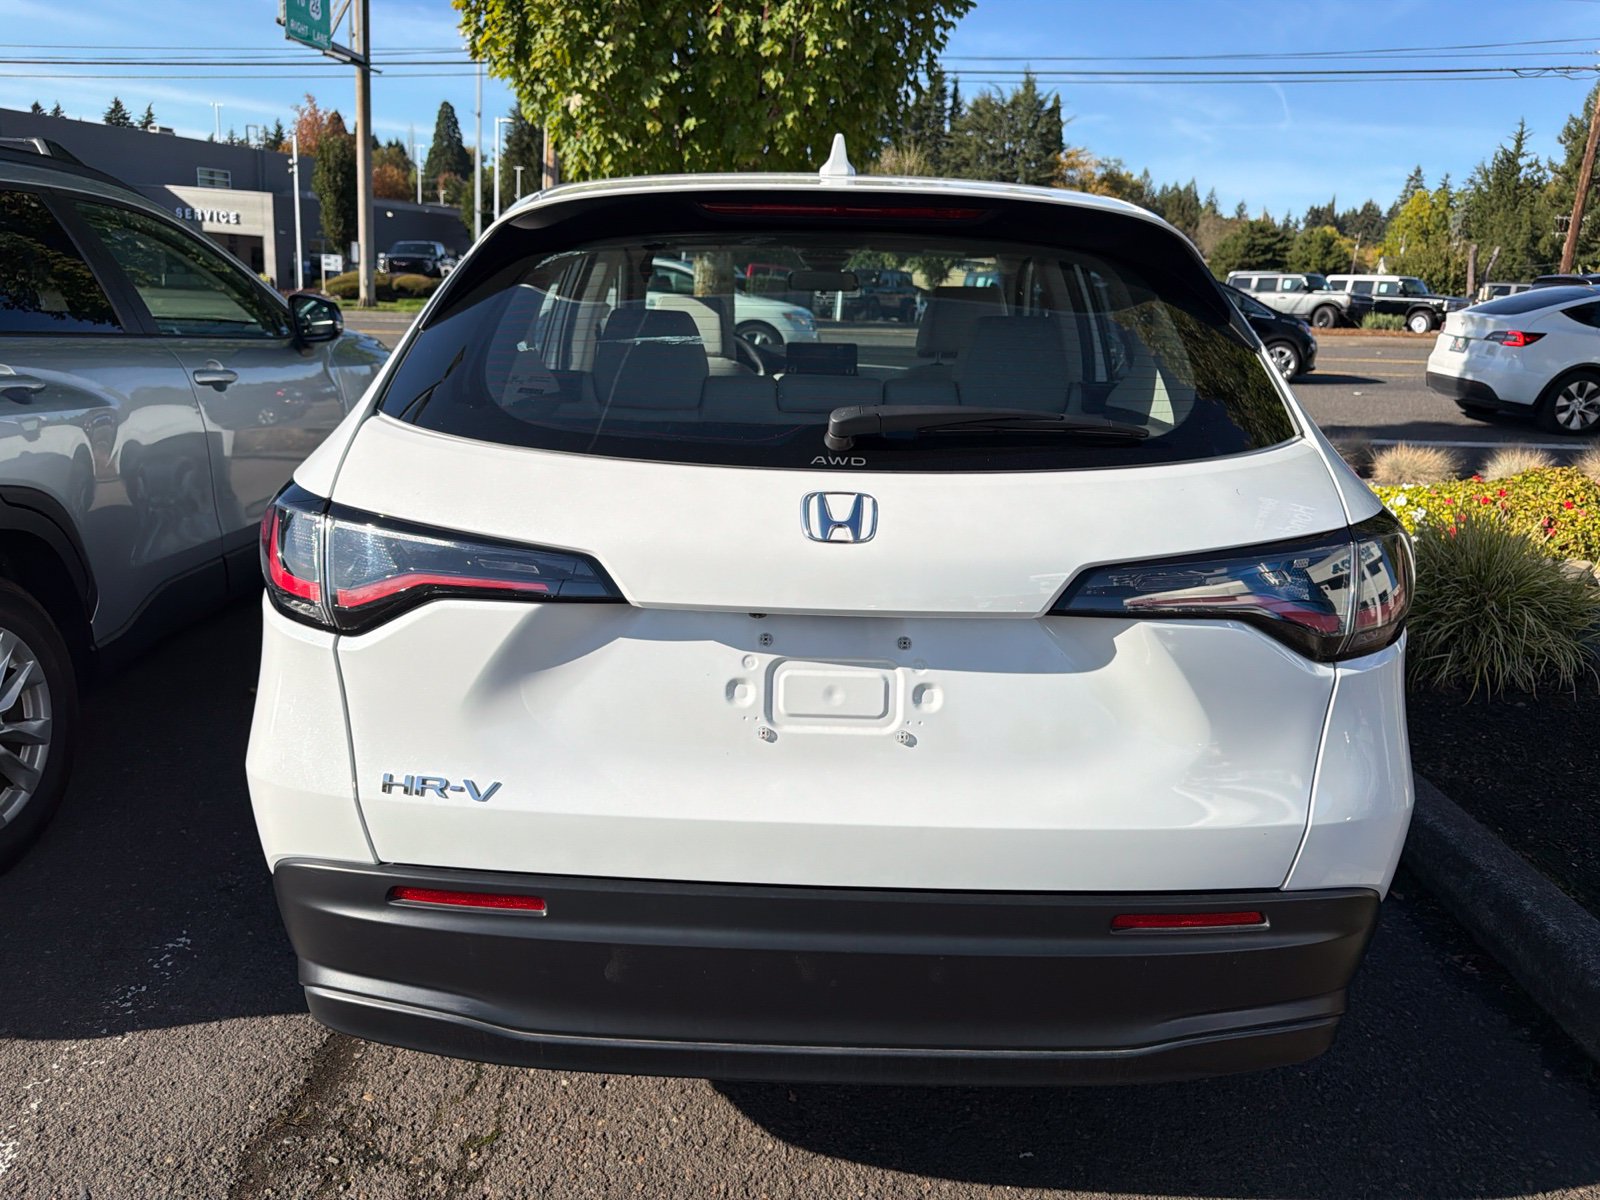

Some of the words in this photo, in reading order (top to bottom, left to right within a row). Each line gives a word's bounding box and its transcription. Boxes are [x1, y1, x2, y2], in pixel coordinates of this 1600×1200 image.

[290, 18, 308, 36] RIGHT
[312, 29, 328, 47] LANE
[175, 207, 240, 224] SERVICE
[810, 456, 867, 466] AWD
[381, 773, 503, 802] HR-V
